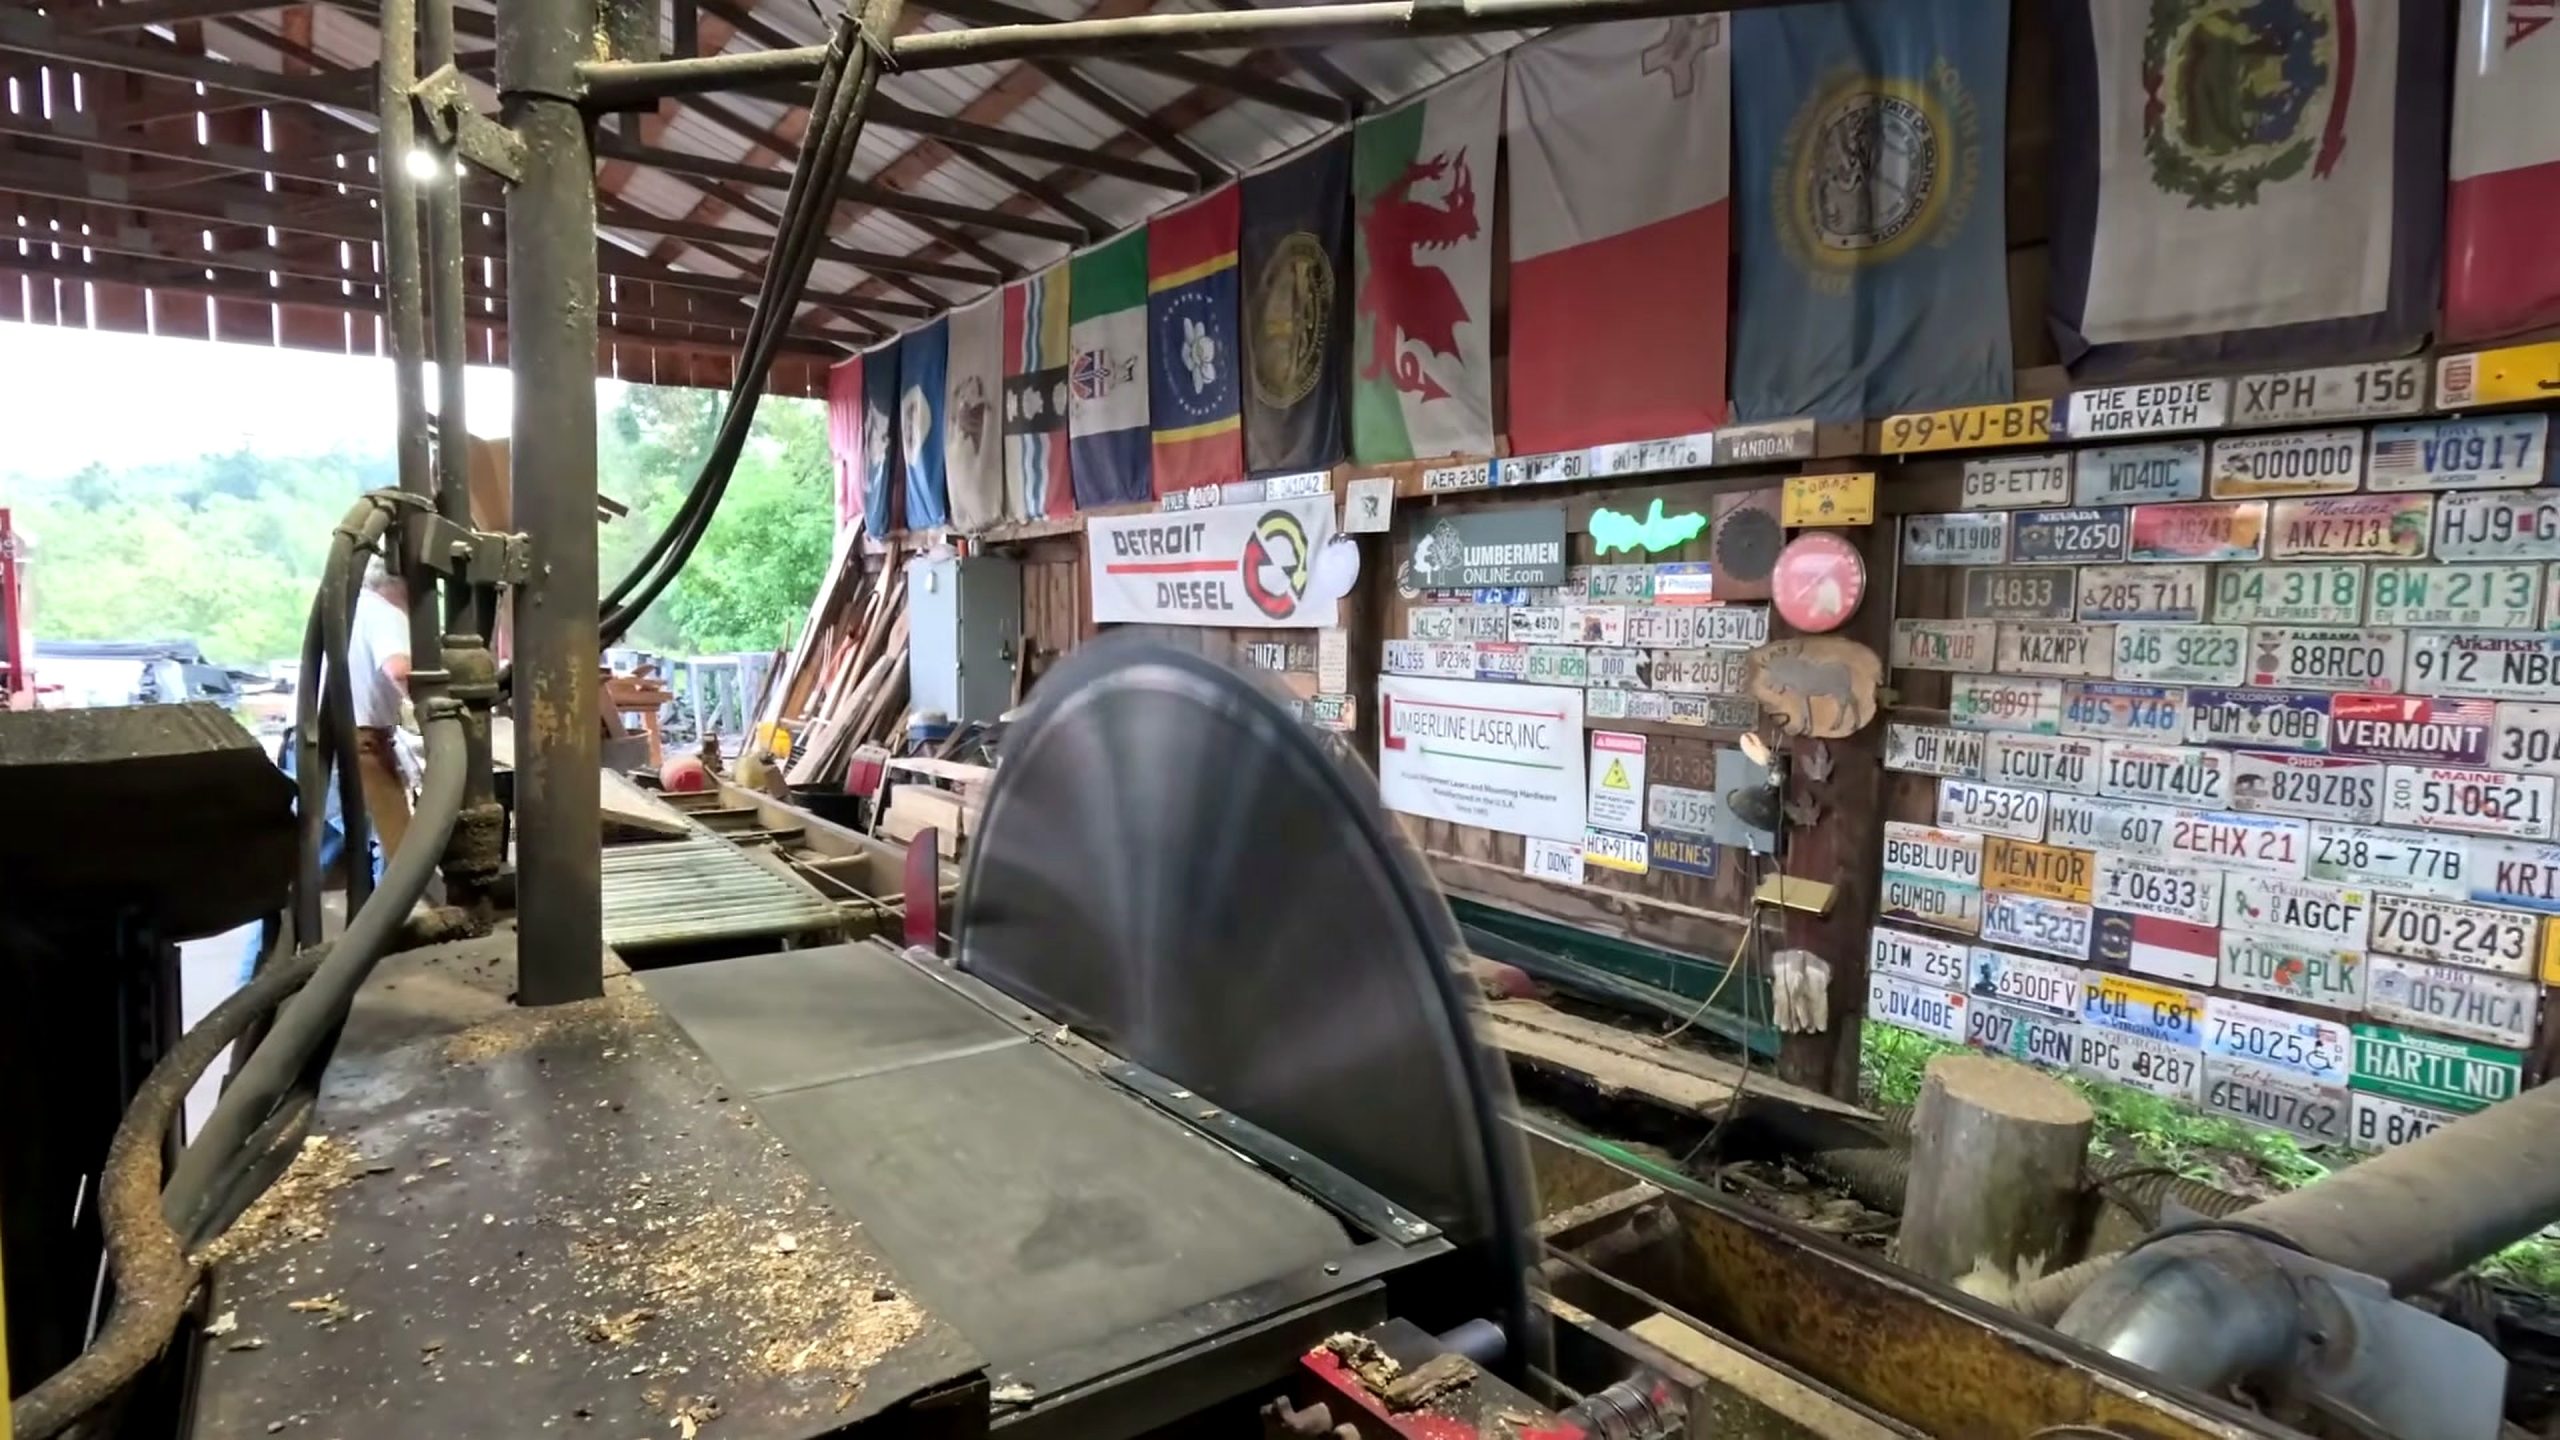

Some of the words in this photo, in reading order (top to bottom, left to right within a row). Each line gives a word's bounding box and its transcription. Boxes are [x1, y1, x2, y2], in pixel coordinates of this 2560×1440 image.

[2083, 390, 2126, 413] THE
[2136, 382, 2212, 408] EDDIE
[2244, 376, 2315, 413] XPH
[2355, 367, 2415, 404] 156
[1893, 405, 2050, 449] 99-VJ-BR
[2090, 405, 2199, 432] HORVATH
[1111, 522, 1206, 556] DETROIT
[2066, 523, 2121, 550] 2650
[1463, 542, 1559, 567] LUMBERMEN
[1463, 567, 1544, 585] ONLINE.com
[2282, 571, 2355, 605] 318
[2447, 572, 2531, 609] 213
[1156, 581, 1234, 610] DIESEL
[2101, 584, 2142, 611] 285
[2152, 583, 2195, 611] 711
[2118, 636, 2161, 664] 346
[2176, 637, 2239, 666] 9223
[2291, 631, 2360, 642] ALABAMA
[2415, 650, 2478, 682] 912
[1914, 736, 1938, 761] OH
[1943, 737, 1982, 769] MAN
[2335, 719, 2483, 754] VERMONT
[2286, 756, 2325, 768] OHIO
[2431, 769, 2507, 785] MAINE
[2052, 806, 2094, 836] HXU
[2120, 816, 2163, 846] 607
[1652, 837, 1712, 868] MARINES
[2172, 821, 2248, 858] 2EHX
[2258, 831, 2296, 864] 21
[1993, 845, 2085, 887] MENTOR
[2130, 872, 2197, 908] 0633
[1925, 951, 1962, 981] 255
[1971, 1011, 2013, 1045] 907
[2028, 1025, 2073, 1063] GRN
[2081, 1037, 2120, 1071] BPG
[2363, 1041, 2507, 1101] HARTLND
